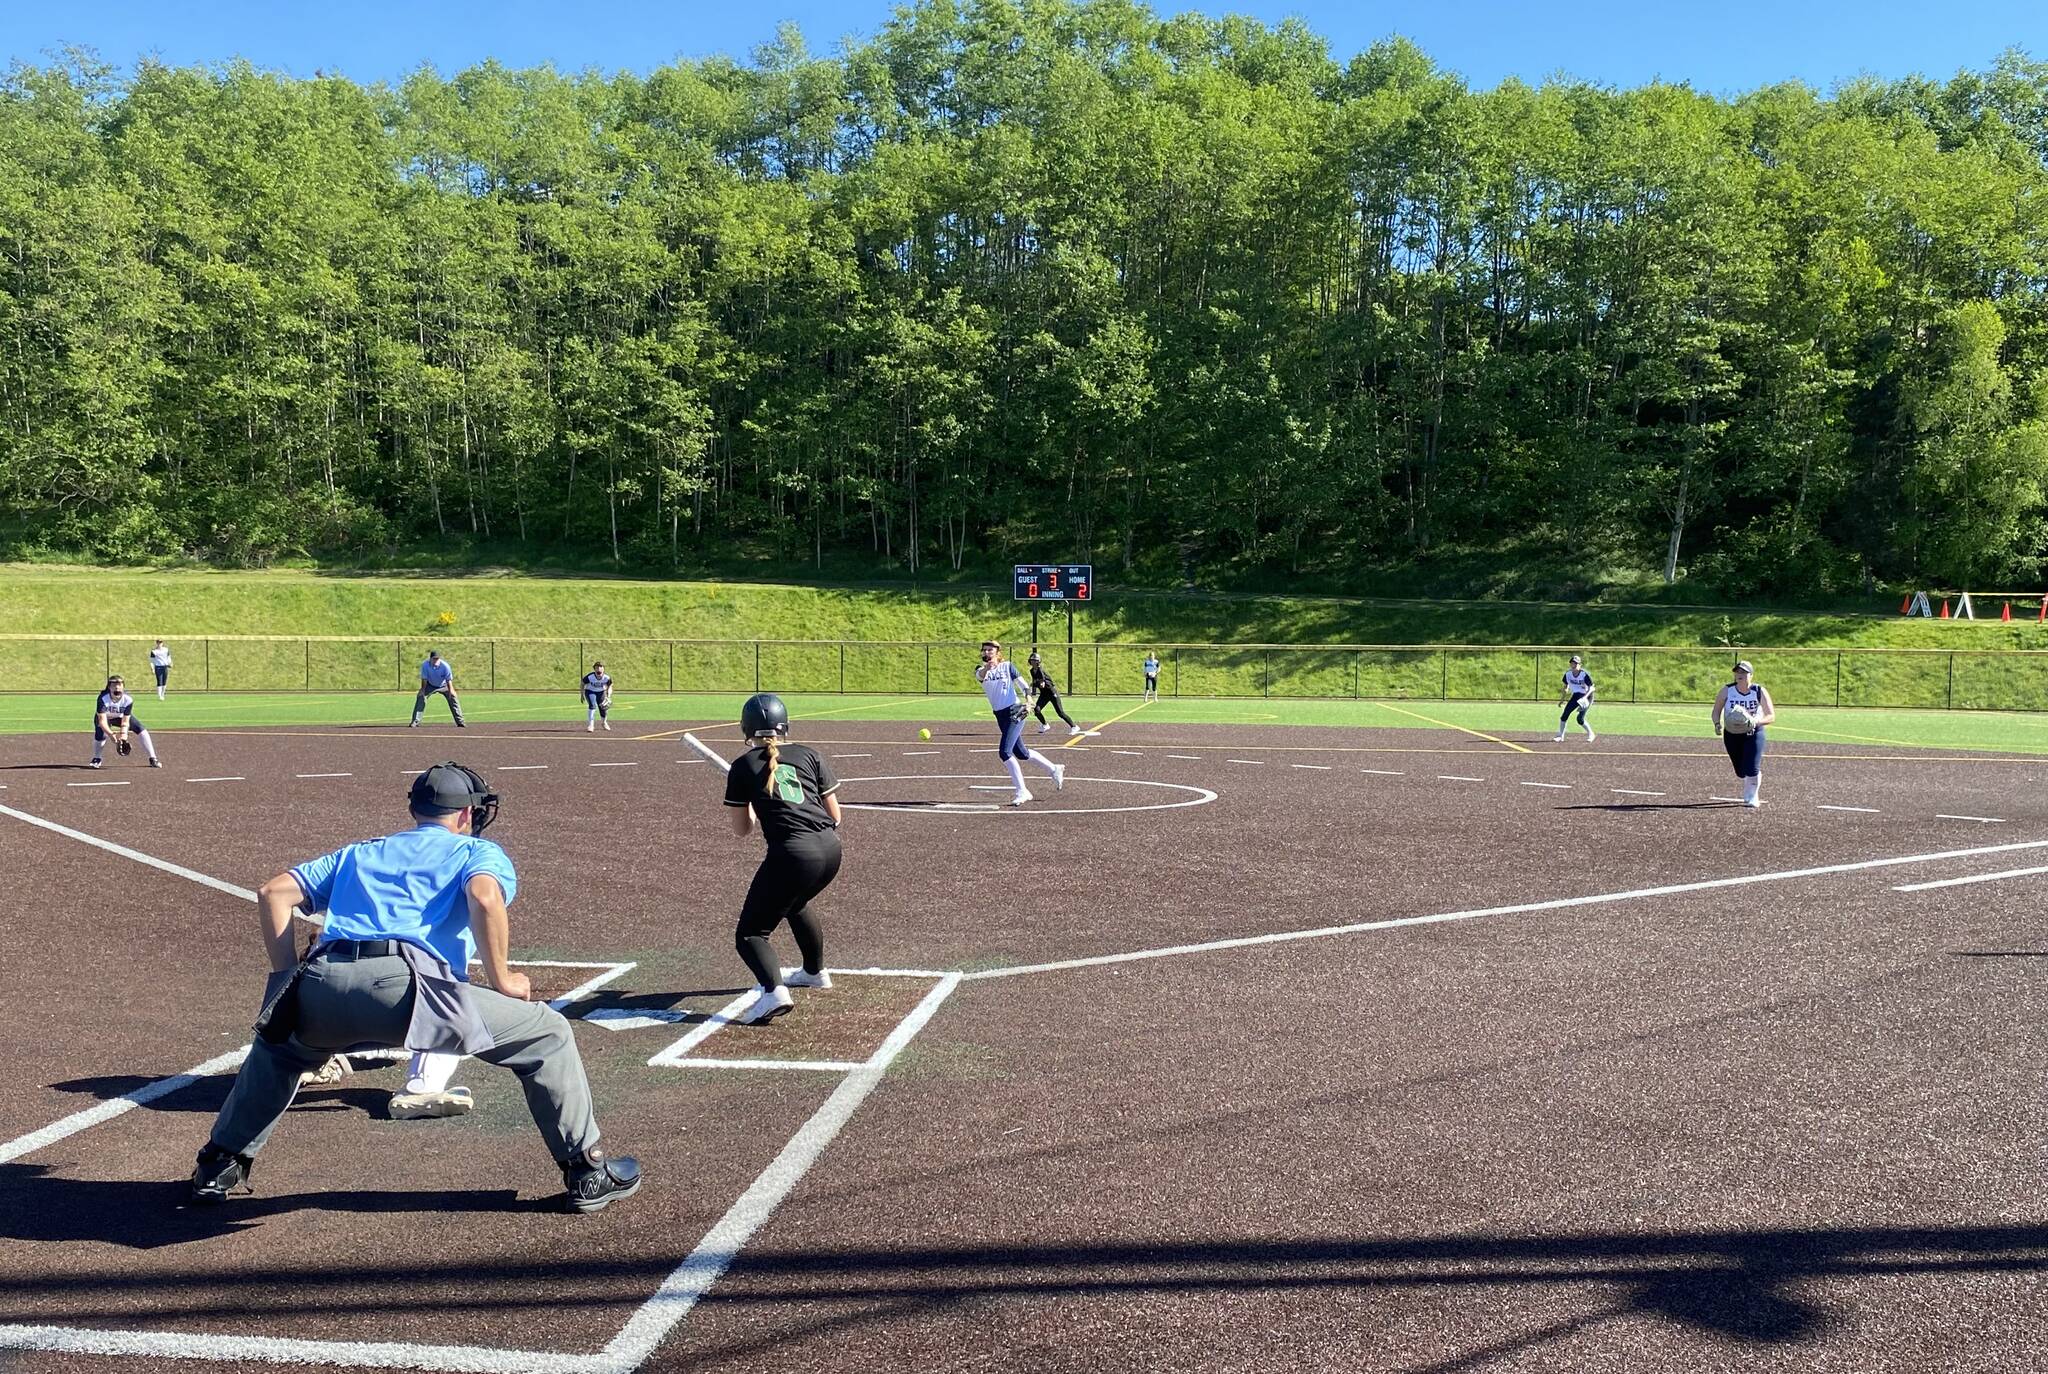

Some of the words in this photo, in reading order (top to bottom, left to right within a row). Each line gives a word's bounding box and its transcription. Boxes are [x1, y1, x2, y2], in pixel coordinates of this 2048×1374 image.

[1049, 574, 1057, 588] 3
[1029, 583, 1038, 597] 0
[1041, 590, 1064, 598] INNING
[1078, 584, 1087, 598] 2
